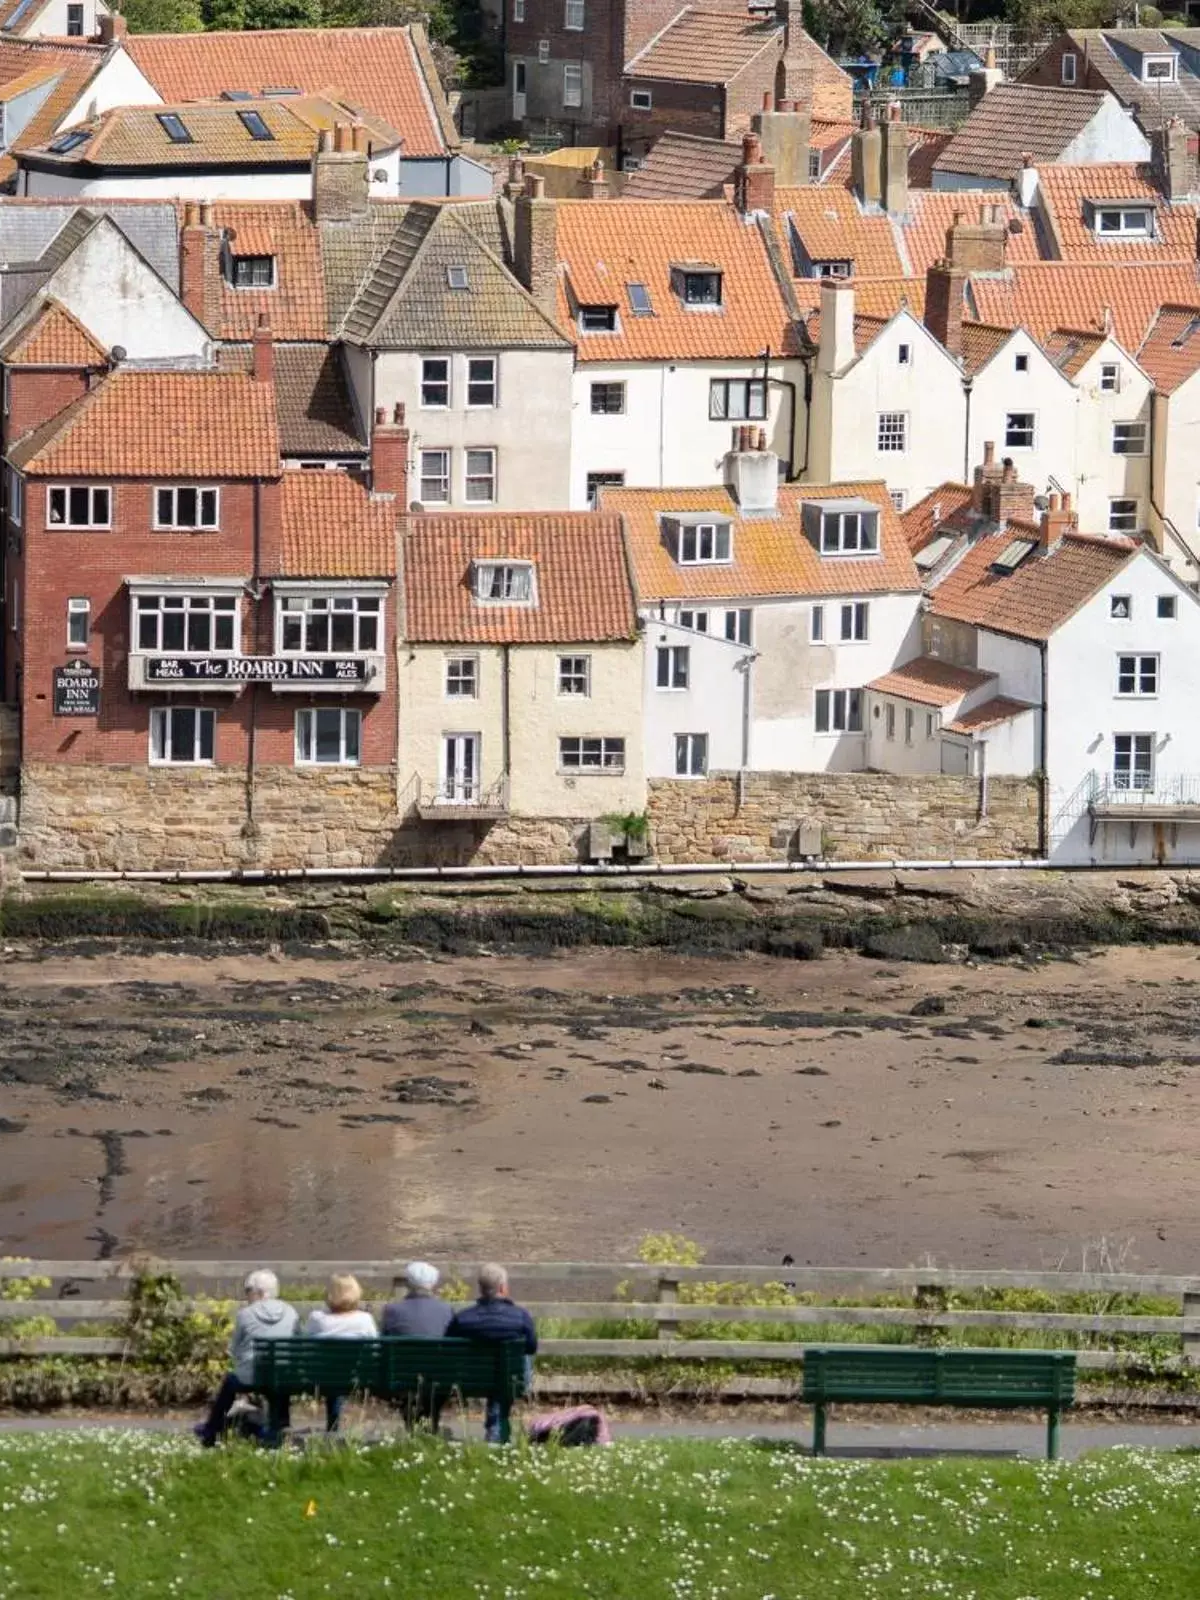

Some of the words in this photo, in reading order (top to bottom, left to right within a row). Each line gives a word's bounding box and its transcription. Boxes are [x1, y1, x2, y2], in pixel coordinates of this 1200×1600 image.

[160, 660, 178, 668] BAR
[190, 660, 222, 675] The
[226, 660, 288, 675] BOARD
[292, 660, 324, 675] INN
[335, 661, 358, 669] REAL
[155, 668, 185, 677] MEALS
[335, 669, 358, 678] ALES
[57, 677, 99, 688] BOARD
[66, 689, 89, 699] INN
